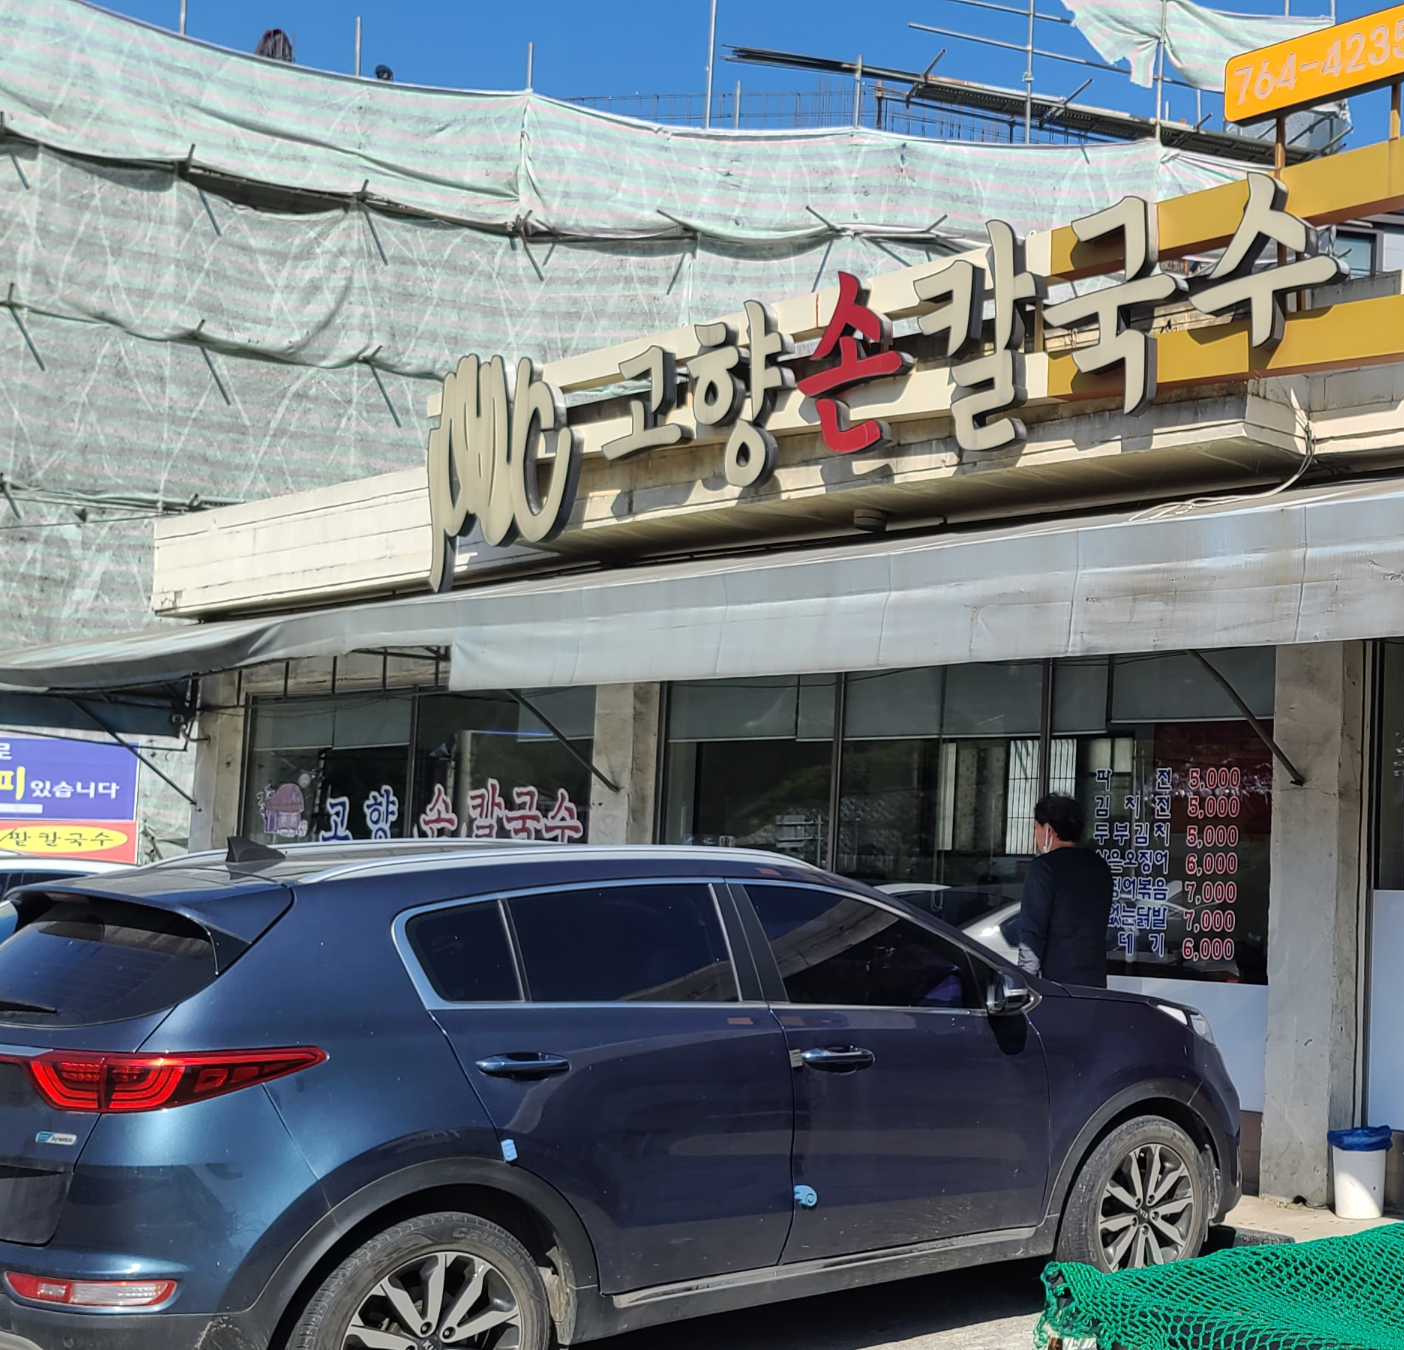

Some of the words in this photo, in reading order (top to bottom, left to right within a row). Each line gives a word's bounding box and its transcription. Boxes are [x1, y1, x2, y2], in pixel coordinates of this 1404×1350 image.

[30, 779, 120, 799] 있습니다
[1189, 766, 1241, 791] 5,000
[1188, 796, 1240, 819] 5,000
[1186, 825, 1239, 848] 5,000
[1186, 852, 1238, 876] 6,000
[1185, 881, 1237, 905] 7,000
[1183, 910, 1236, 933] 7,000
[1182, 938, 1235, 961] 6,000
